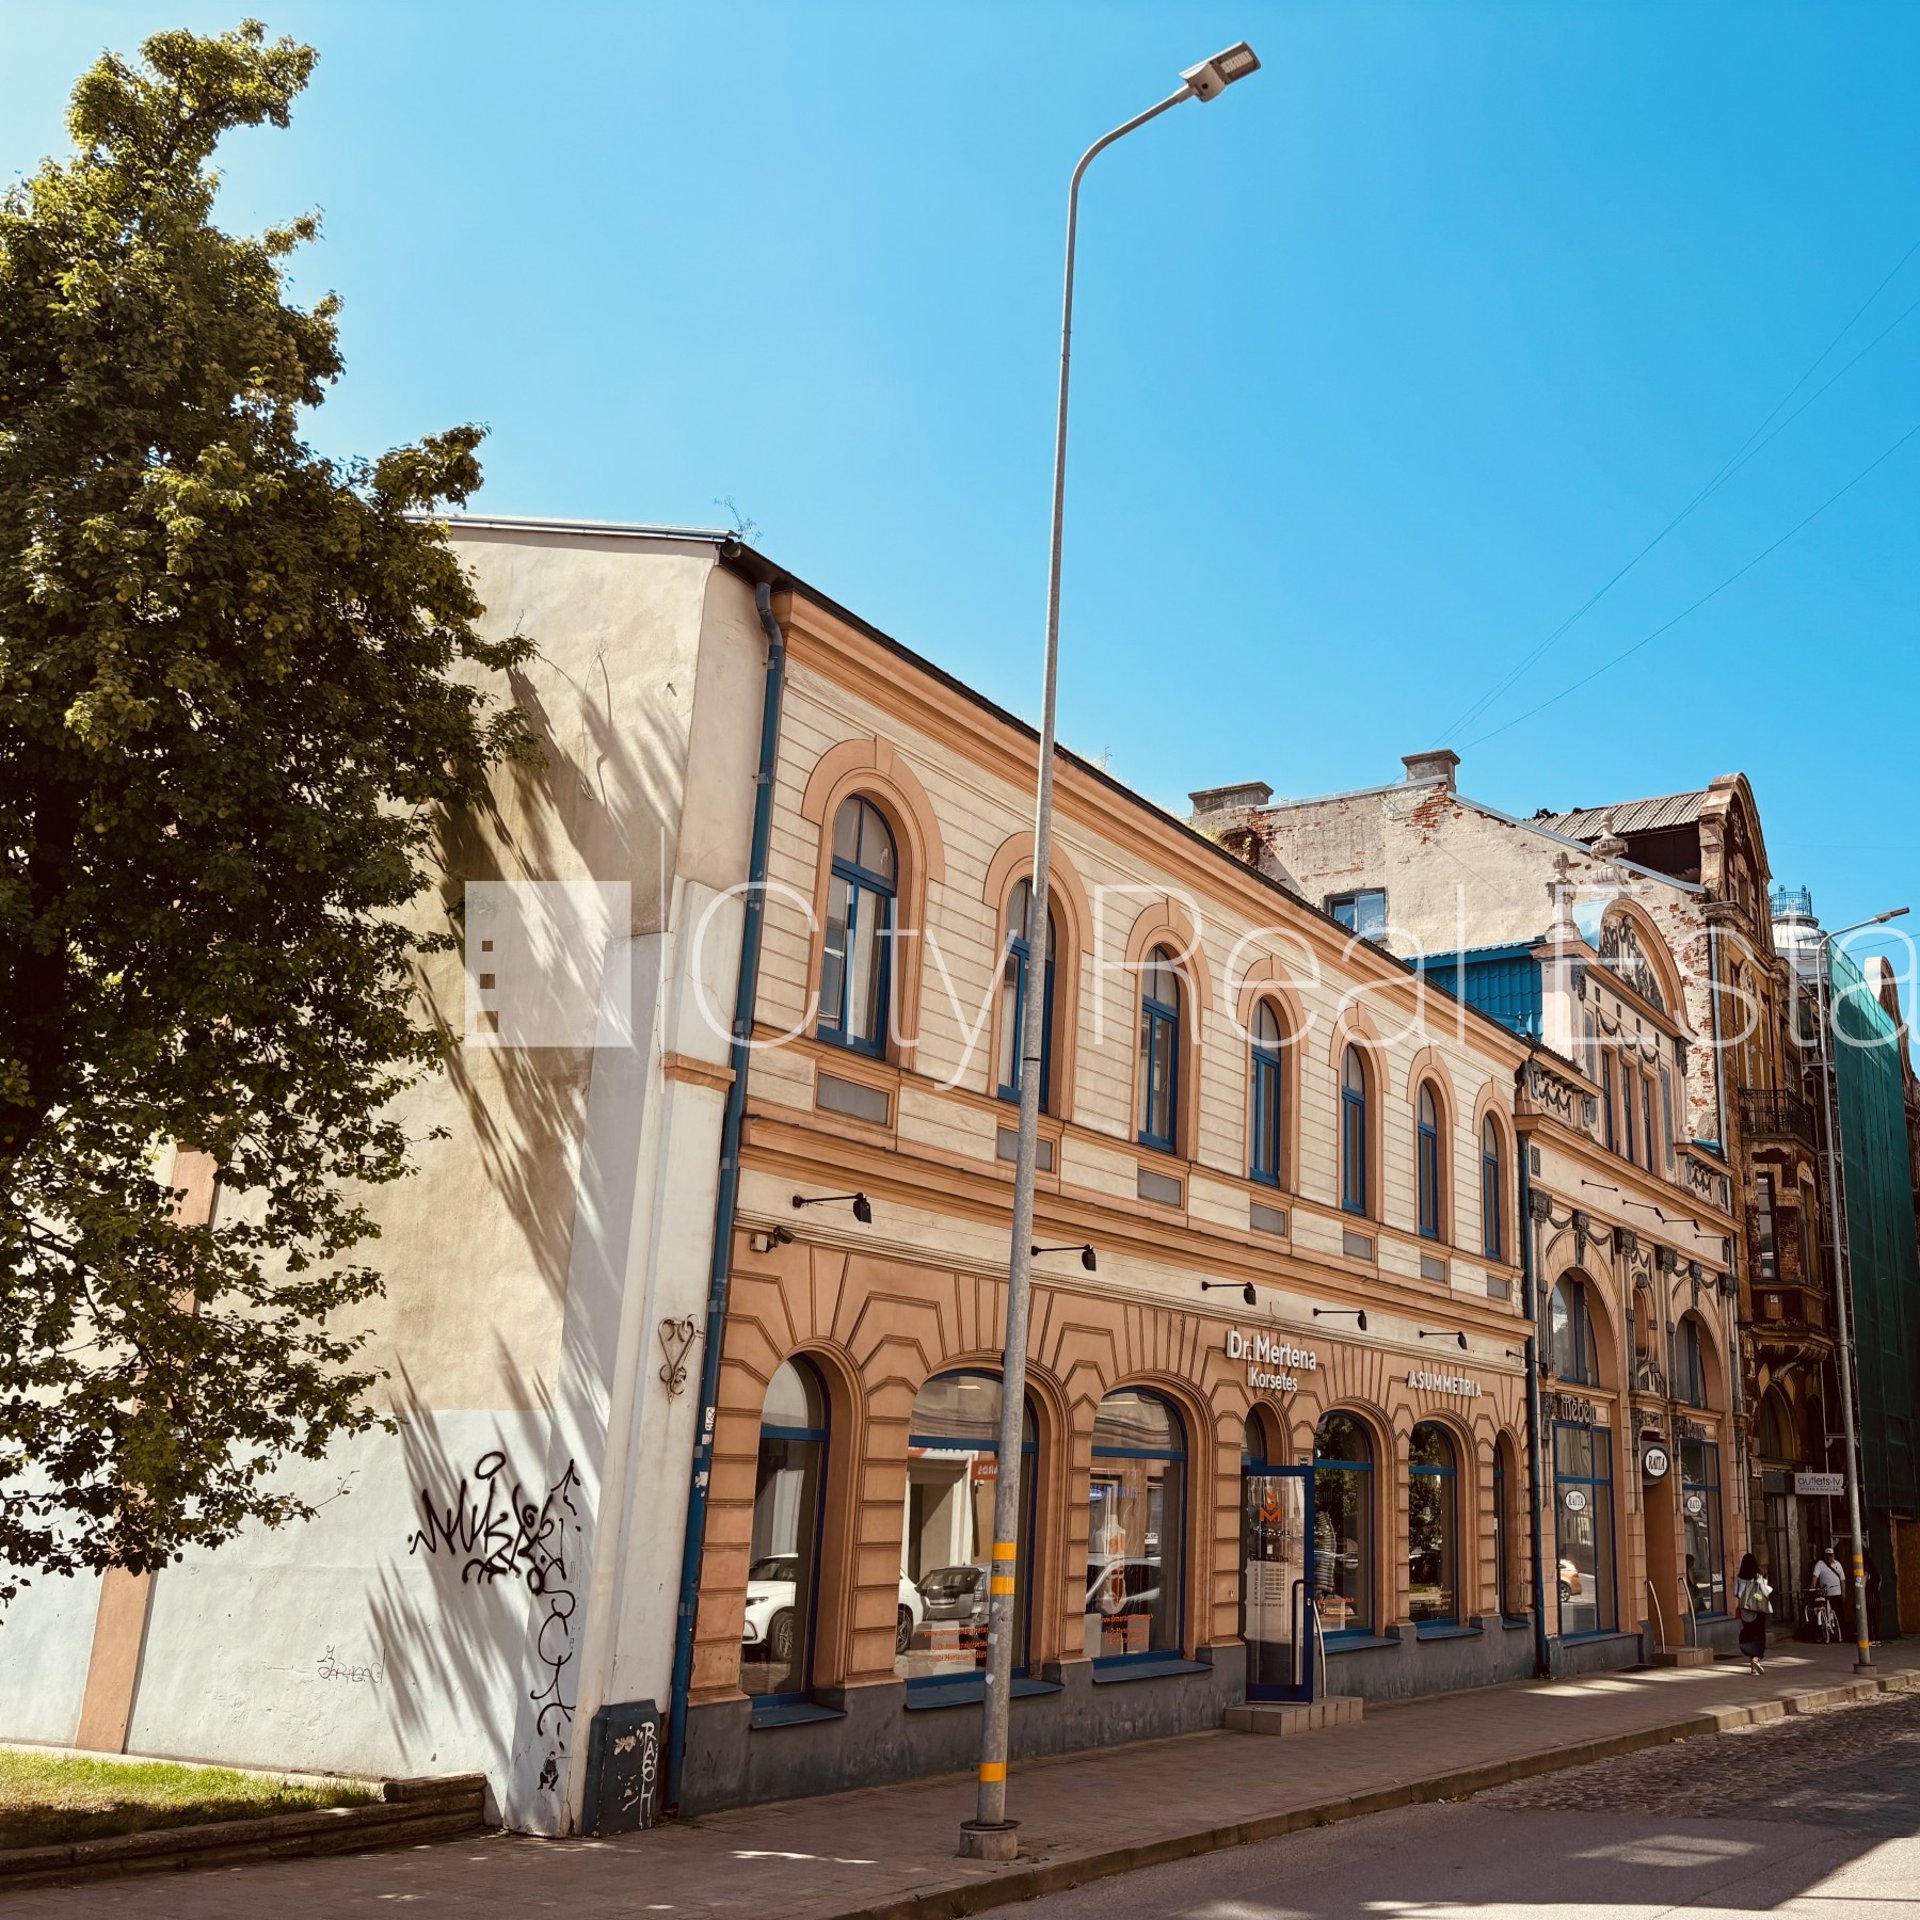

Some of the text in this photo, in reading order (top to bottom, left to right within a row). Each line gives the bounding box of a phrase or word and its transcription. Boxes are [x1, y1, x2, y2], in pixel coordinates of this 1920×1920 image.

[1227, 1330, 1317, 1370] Dr. Mertena
[1248, 1366, 1298, 1392] Korsetes
[1407, 1370, 1483, 1398] ASUMMETRIA
